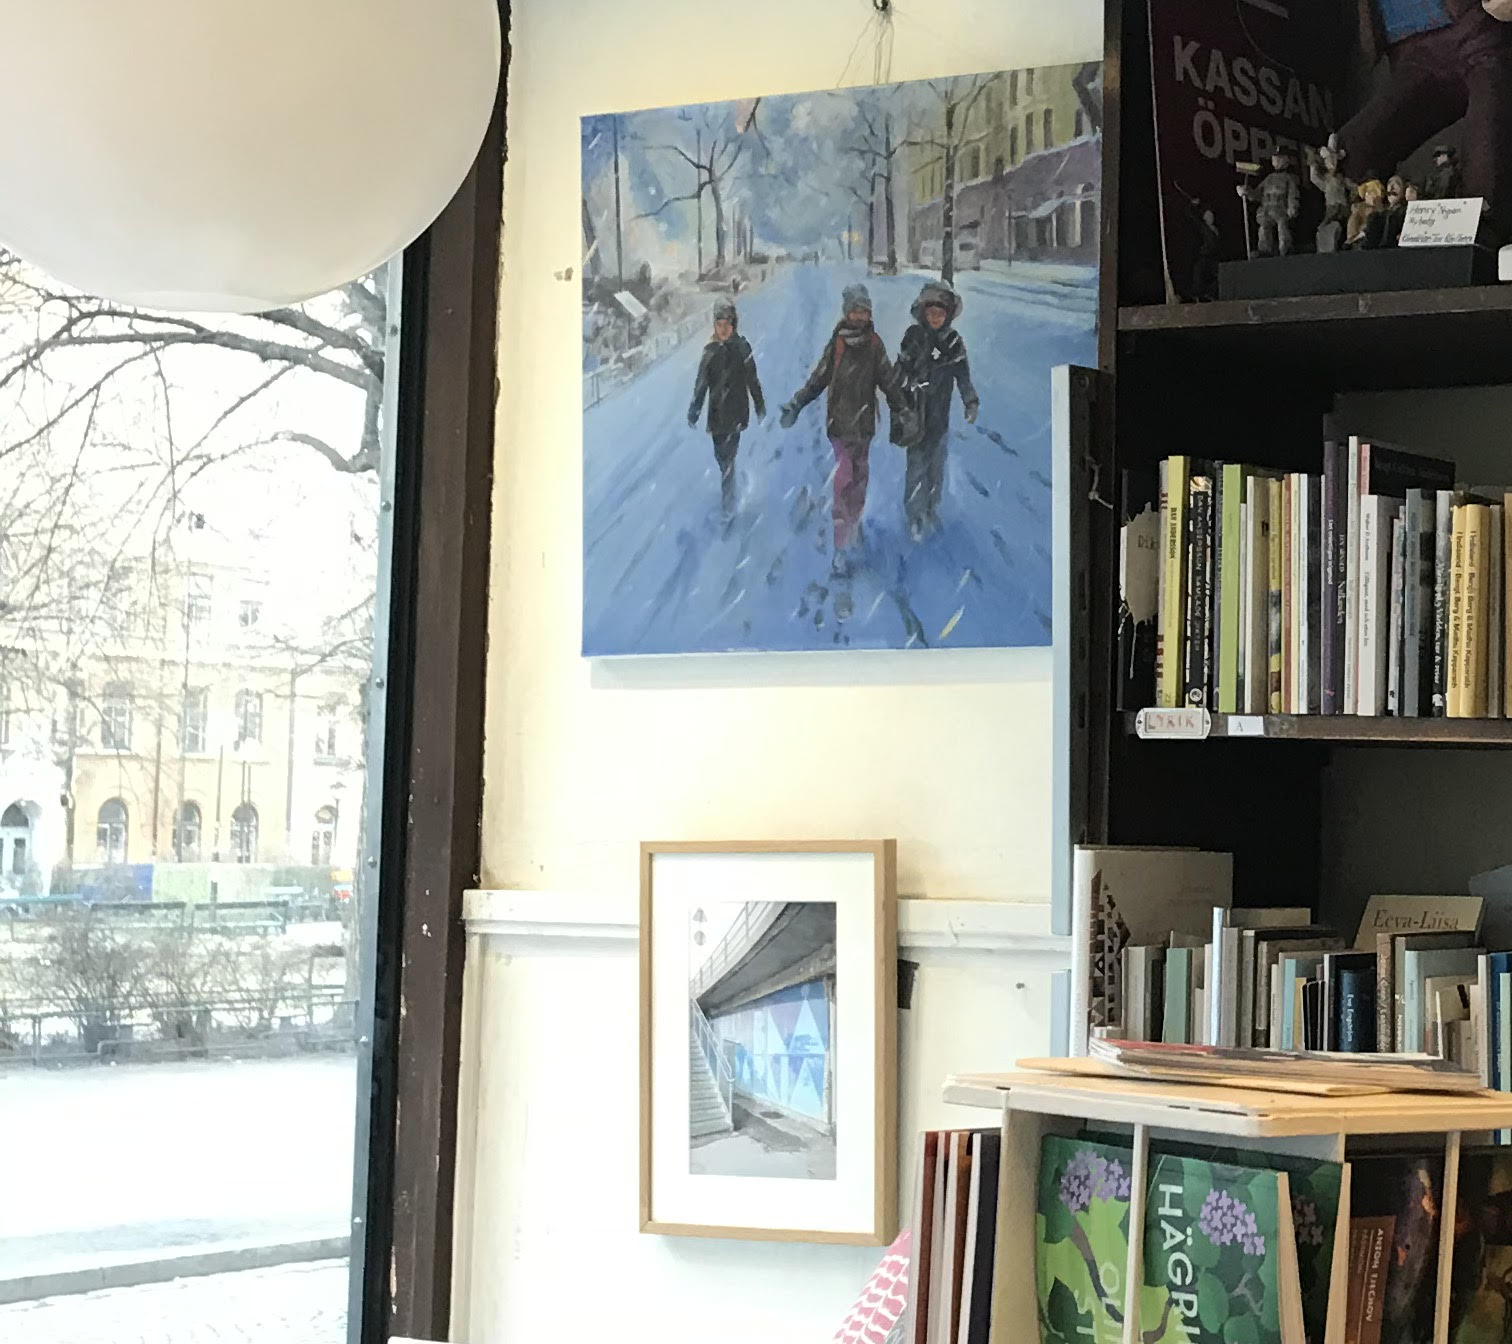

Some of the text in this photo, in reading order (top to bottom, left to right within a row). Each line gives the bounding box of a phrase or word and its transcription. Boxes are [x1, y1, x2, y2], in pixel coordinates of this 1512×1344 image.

[1172, 34, 1336, 131] KASSAN
[1149, 714, 1195, 730] LYRIK
[1371, 1227, 1385, 1269] ANTON
